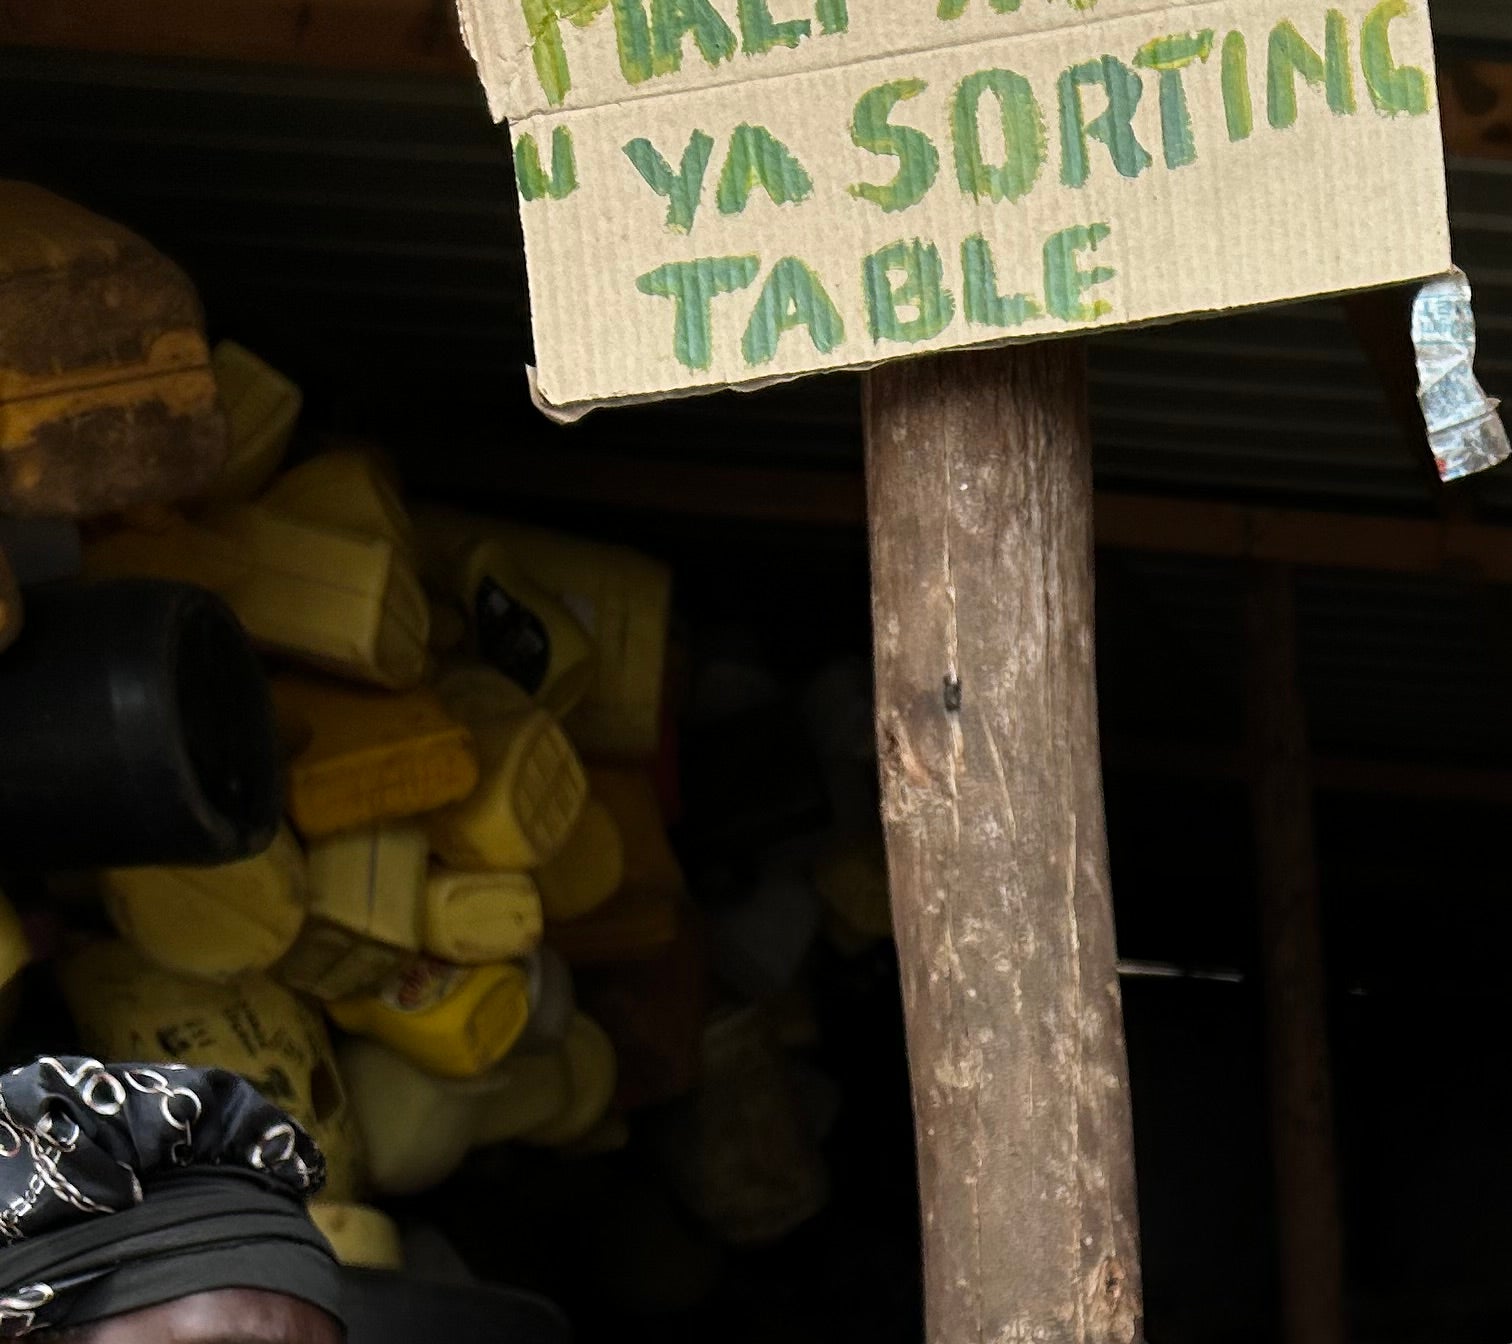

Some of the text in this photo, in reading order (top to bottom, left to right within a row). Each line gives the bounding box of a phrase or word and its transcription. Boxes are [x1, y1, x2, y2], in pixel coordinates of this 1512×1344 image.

[622, 122, 814, 235] YA
[848, 0, 1430, 212] SORTING
[635, 222, 1117, 371] TABLE
